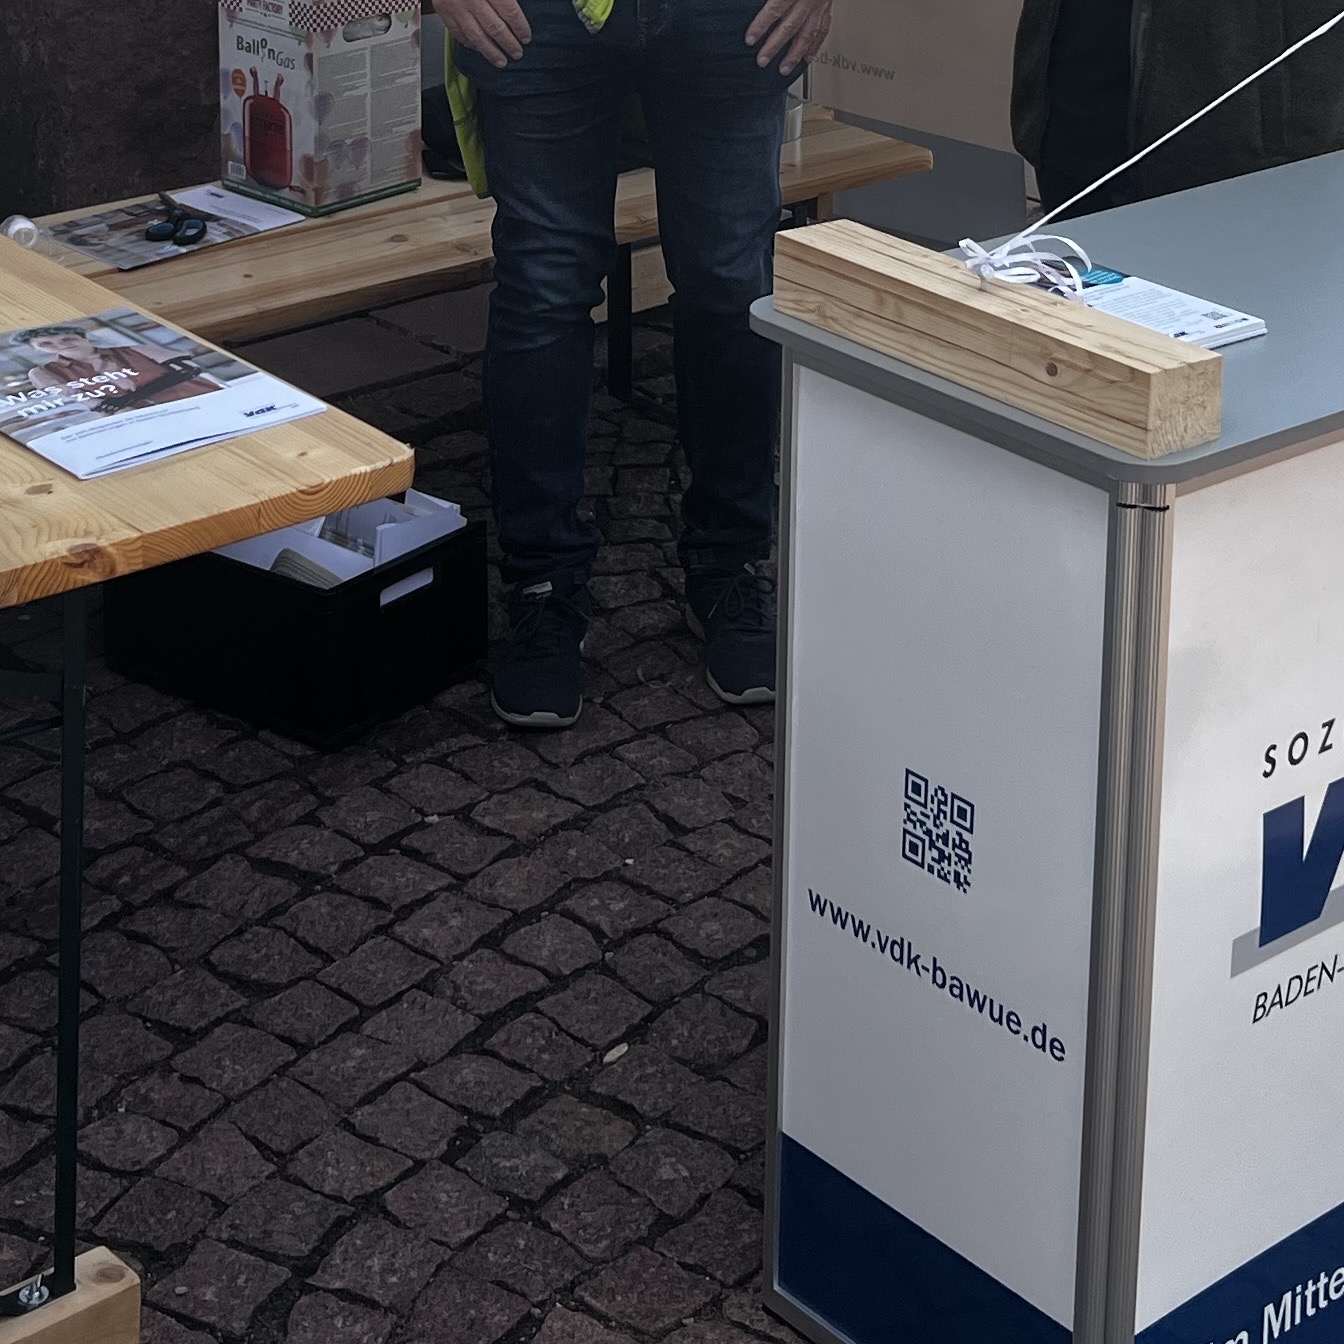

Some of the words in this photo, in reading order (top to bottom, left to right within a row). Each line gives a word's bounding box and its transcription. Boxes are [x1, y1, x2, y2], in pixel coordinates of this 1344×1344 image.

[66, 366, 140, 389] steht
[17, 397, 66, 419] mir
[70, 383, 122, 404] zu?
[807, 888, 1068, 1063] www.vdk-bawue.de
